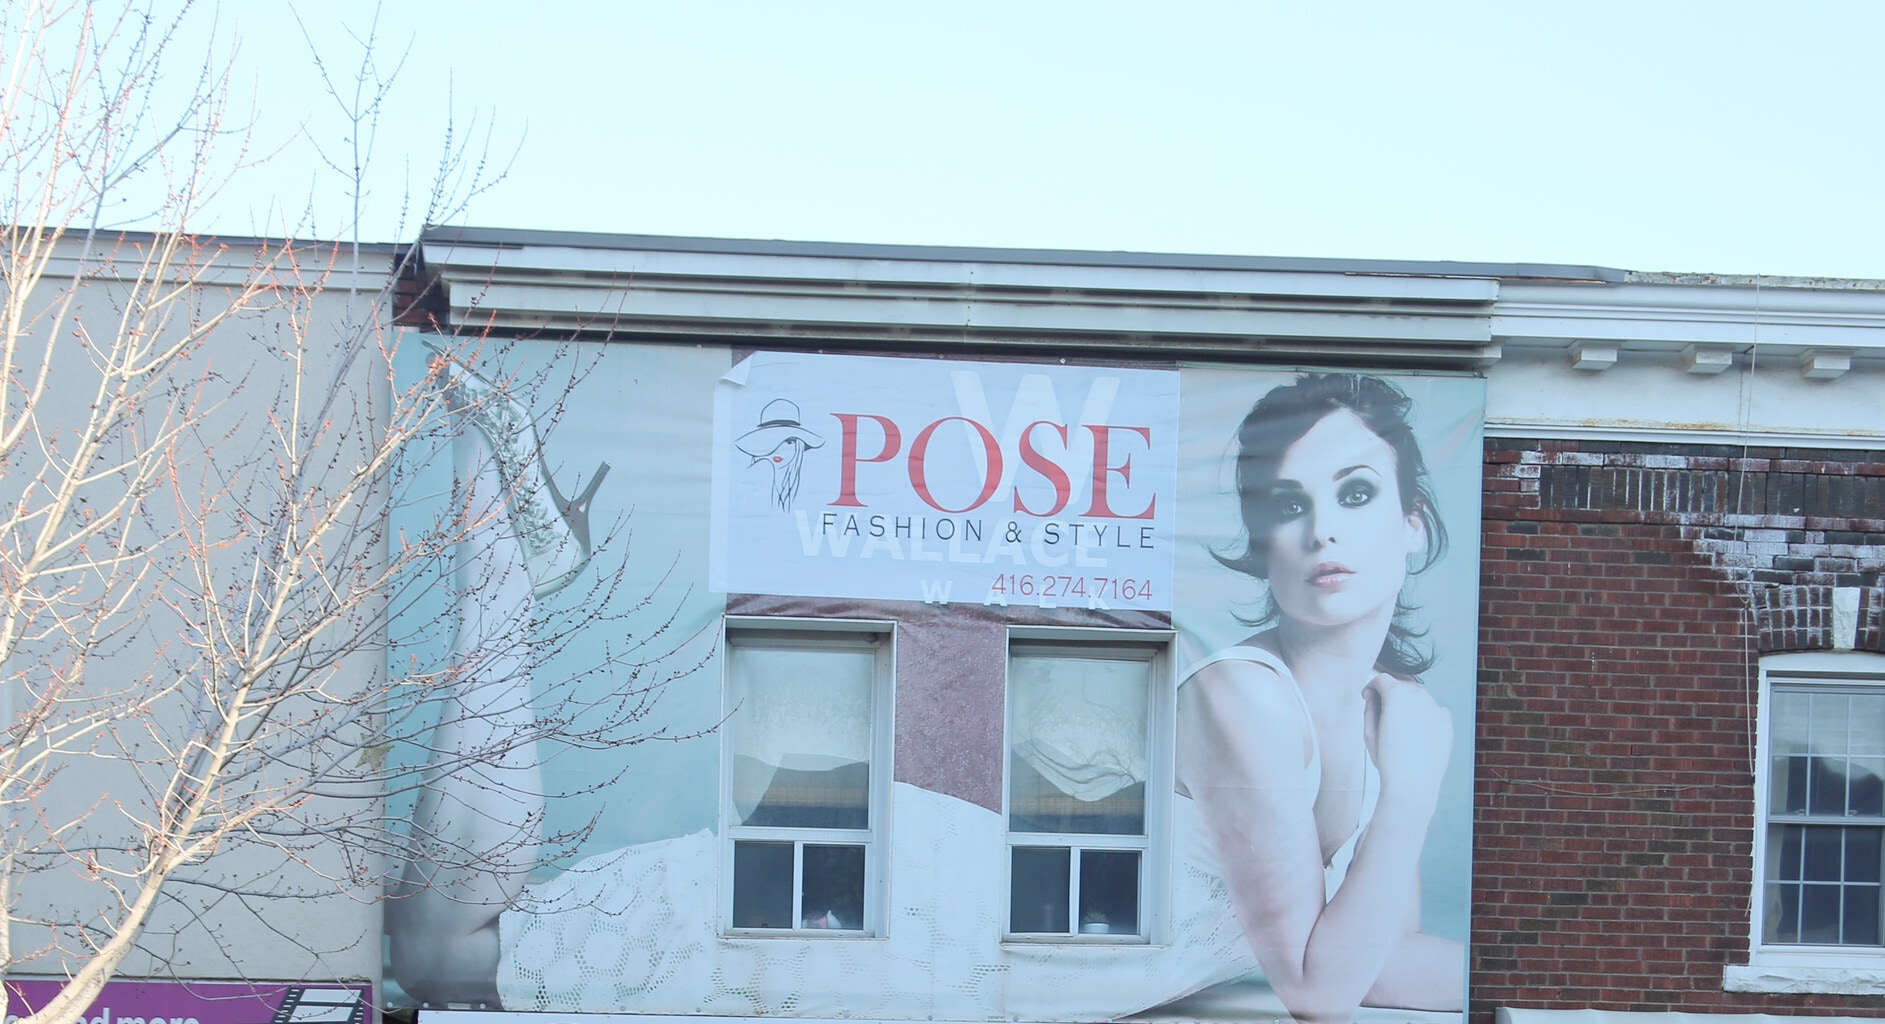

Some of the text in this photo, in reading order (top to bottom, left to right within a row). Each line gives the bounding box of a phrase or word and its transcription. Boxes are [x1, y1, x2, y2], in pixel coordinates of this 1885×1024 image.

[827, 412, 1156, 519] POSE
[794, 508, 1108, 567] WALLACE
[822, 512, 1155, 549] FASHION & STYLE
[991, 573, 1153, 600] 416.274.7164
